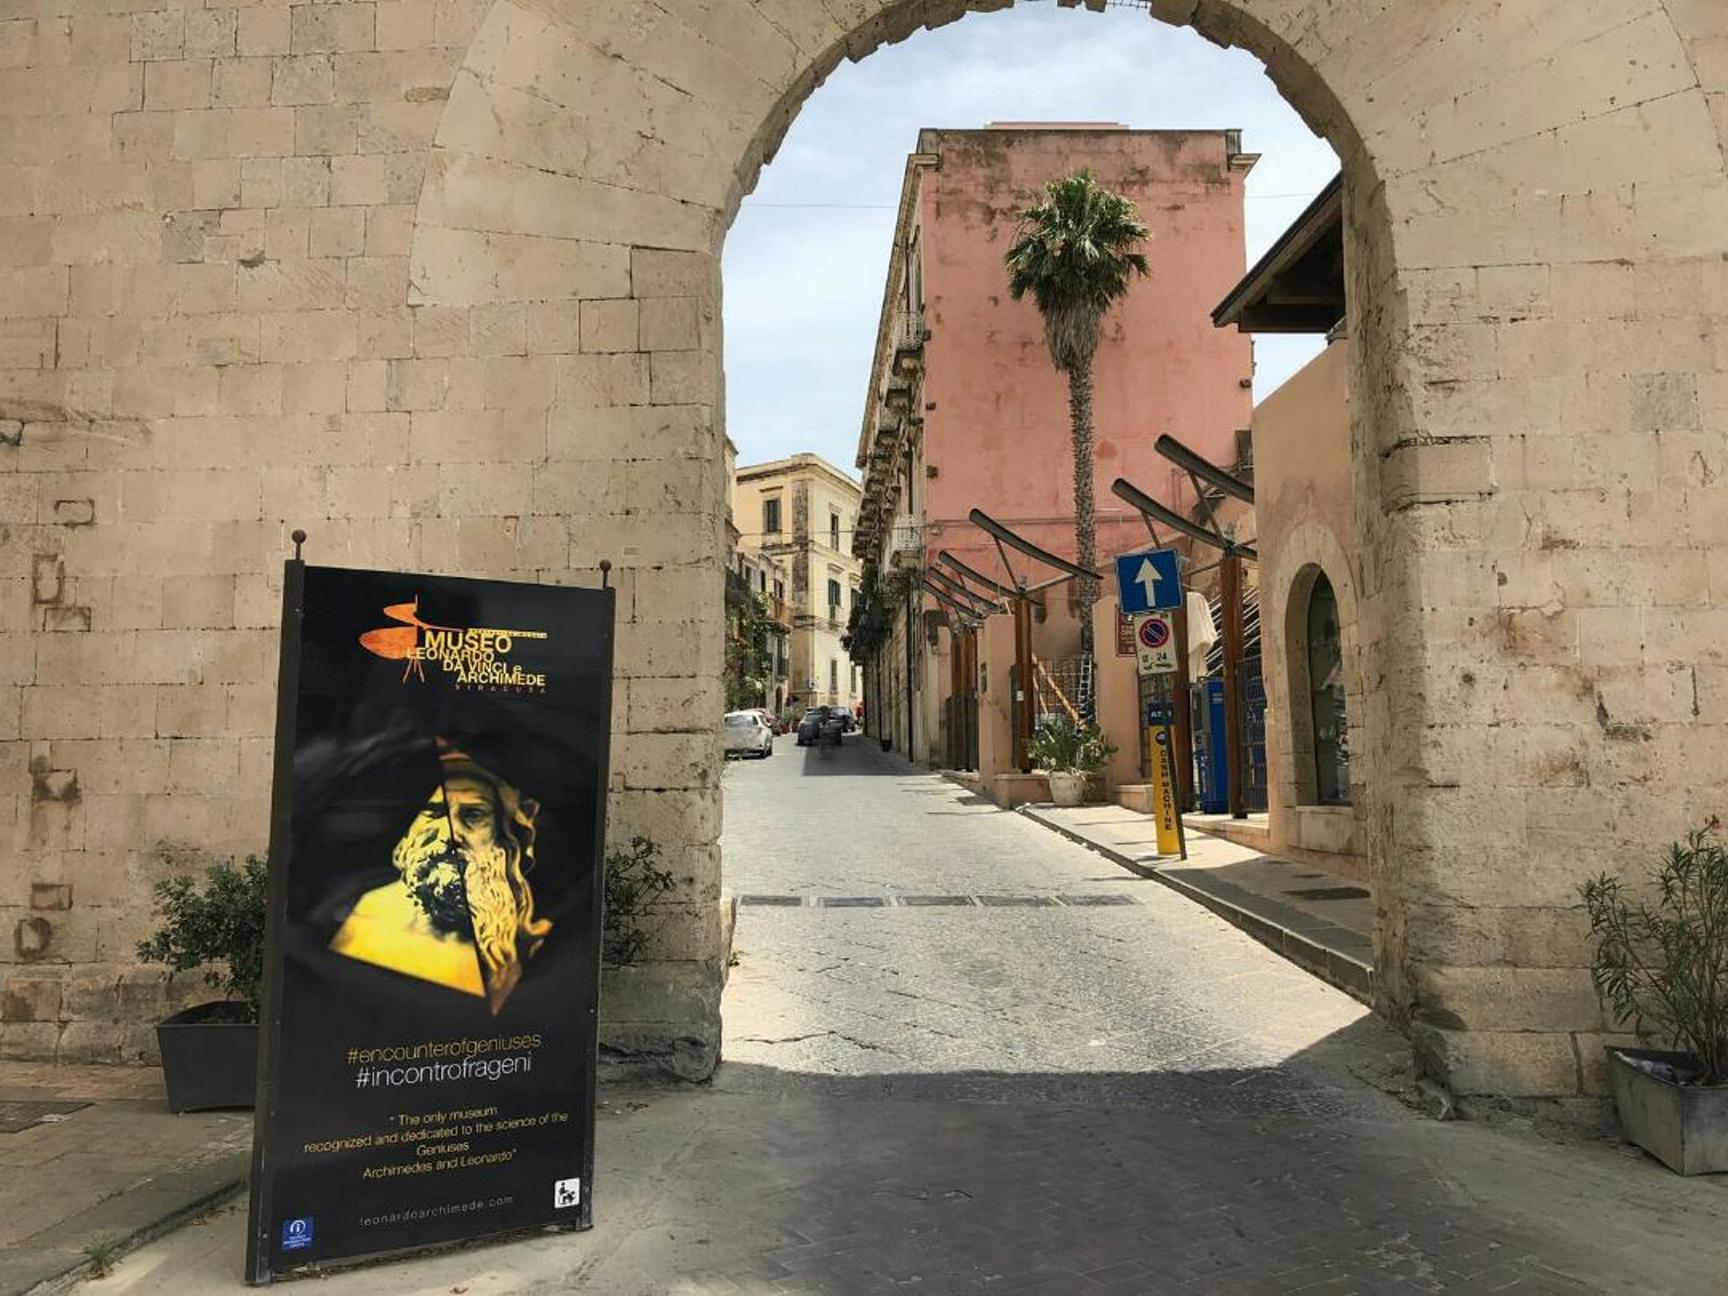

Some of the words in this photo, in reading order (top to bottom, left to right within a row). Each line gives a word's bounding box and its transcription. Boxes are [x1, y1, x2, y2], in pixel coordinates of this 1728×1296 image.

[425, 630, 512, 654] MUSEO
[406, 647, 494, 663] LEONARDO
[443, 658, 463, 672] DA
[467, 659, 506, 674] VINCI
[513, 664, 522, 674] e
[457, 672, 546, 687] ARCHIMEDE
[346, 1033, 542, 1066] #encounterofgeniuses
[355, 1052, 532, 1088] #incontrofrageni
[398, 1113, 420, 1126] The
[423, 1110, 447, 1126] only
[449, 1105, 498, 1121] museum
[304, 1135, 372, 1153] recognized
[375, 1133, 398, 1146] and
[400, 1126, 458, 1142] dedicated
[461, 1125, 473, 1135] to
[475, 1121, 492, 1133] the
[493, 1116, 536, 1131] science
[538, 1113, 550, 1125] of
[551, 1111, 568, 1123] the
[416, 1140, 470, 1156] Geniuses
[362, 1162, 433, 1179] Archimedes
[435, 1157, 458, 1170] and
